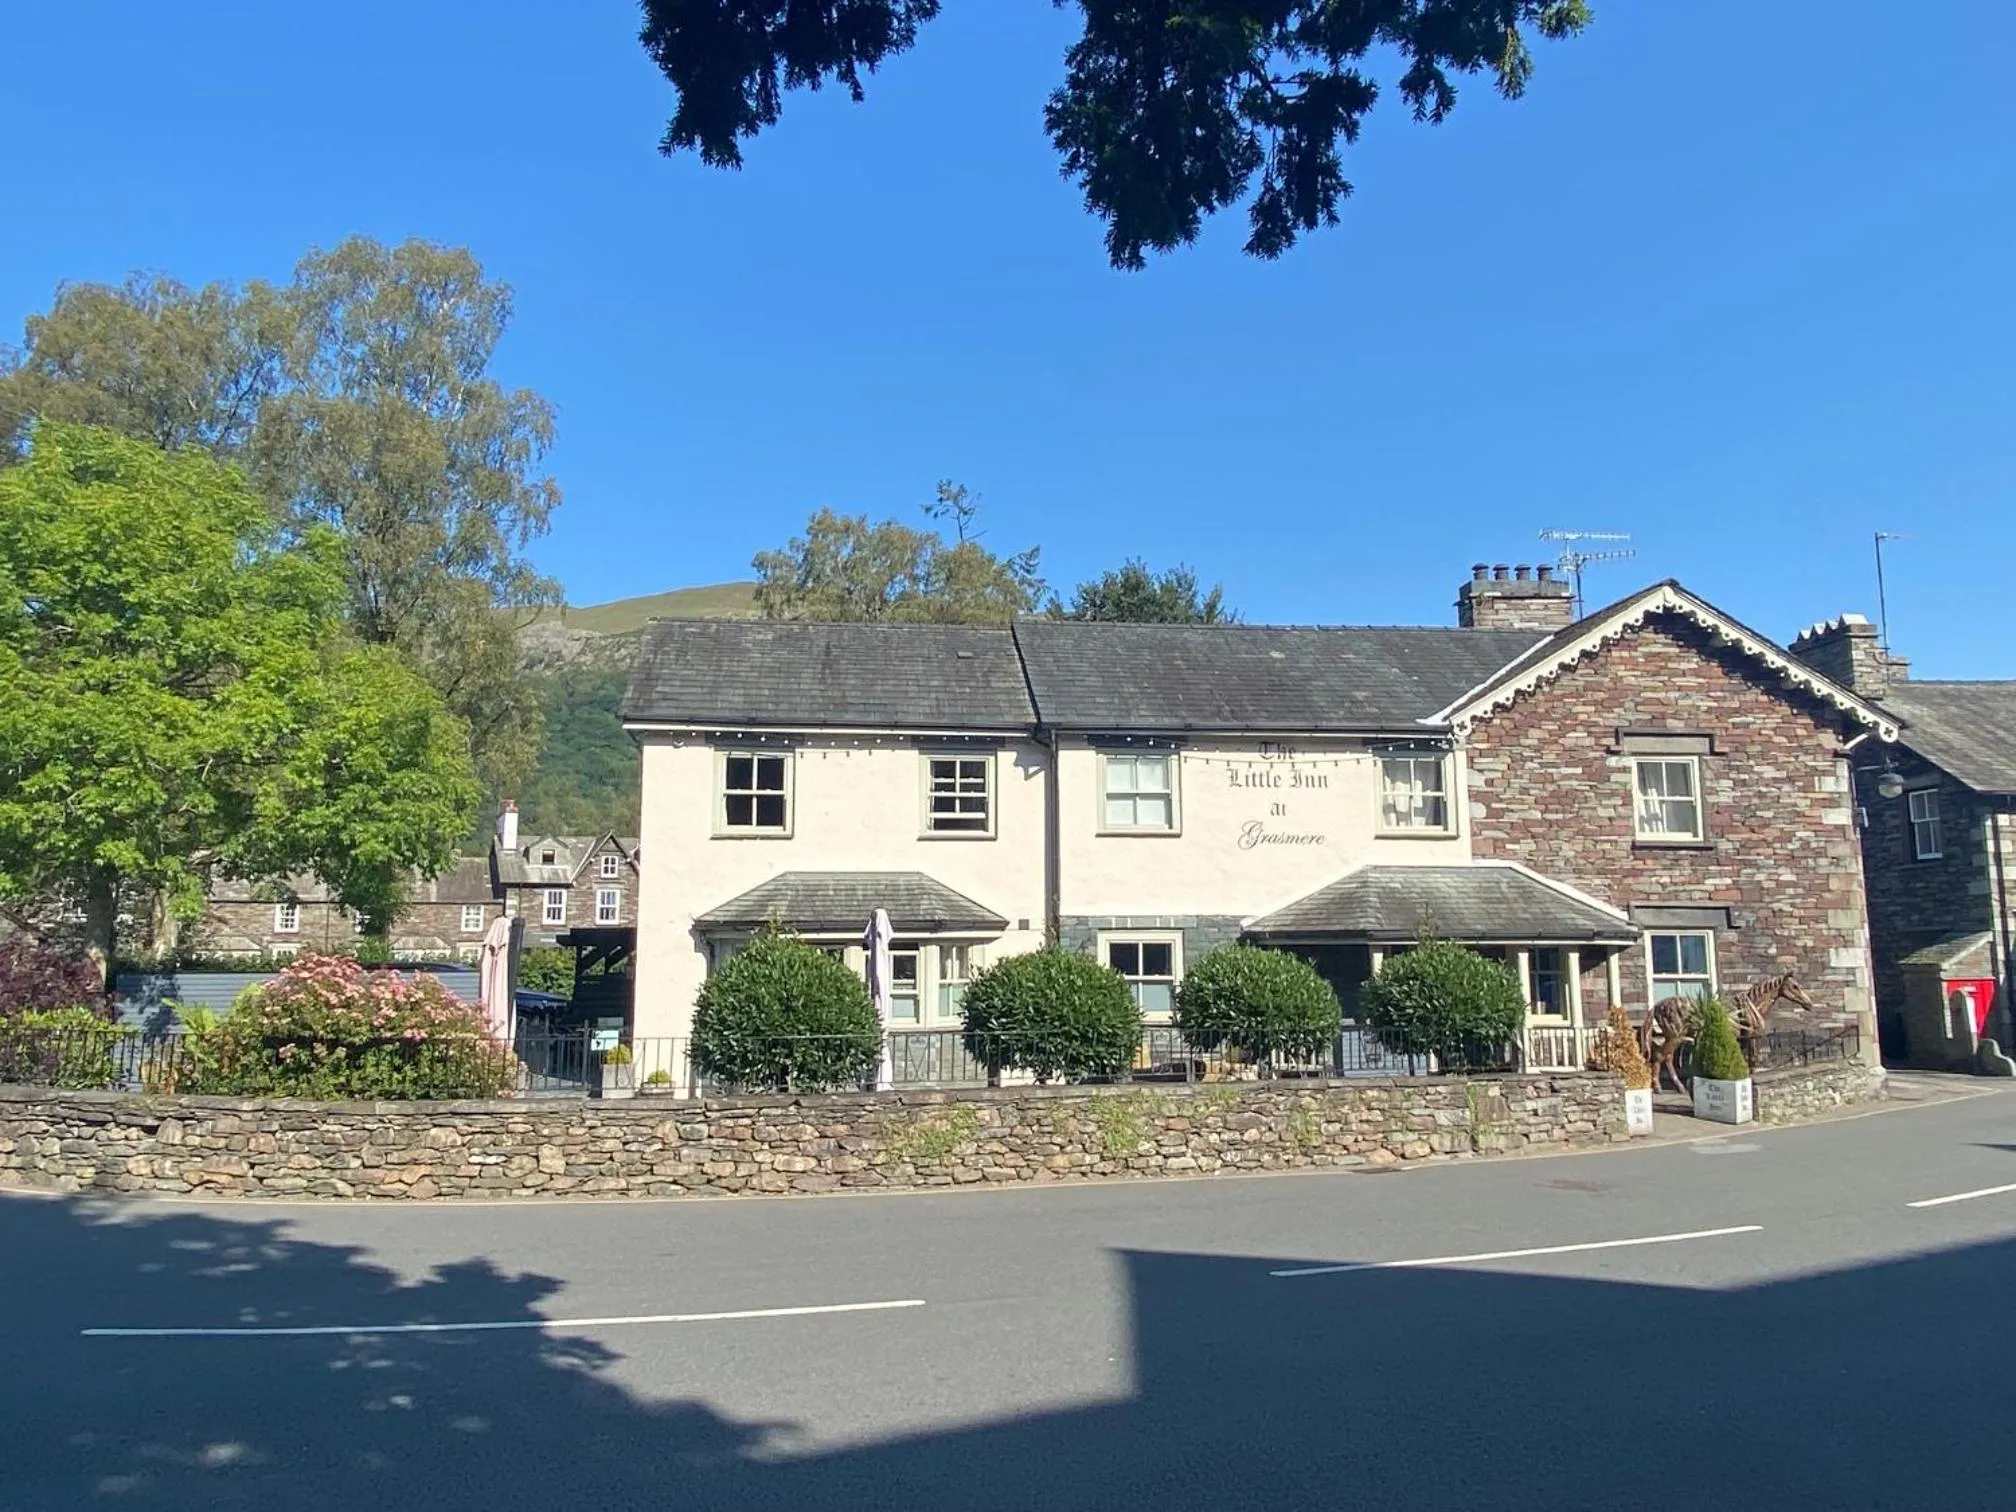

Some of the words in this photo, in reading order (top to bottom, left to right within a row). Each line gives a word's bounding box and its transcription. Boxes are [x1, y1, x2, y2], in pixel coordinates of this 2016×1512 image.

[1258, 741, 1296, 761] The
[1228, 768, 1282, 788] Little
[1290, 768, 1328, 788] Inn
[1270, 802, 1287, 816] at
[1237, 820, 1327, 850] Grasmere
